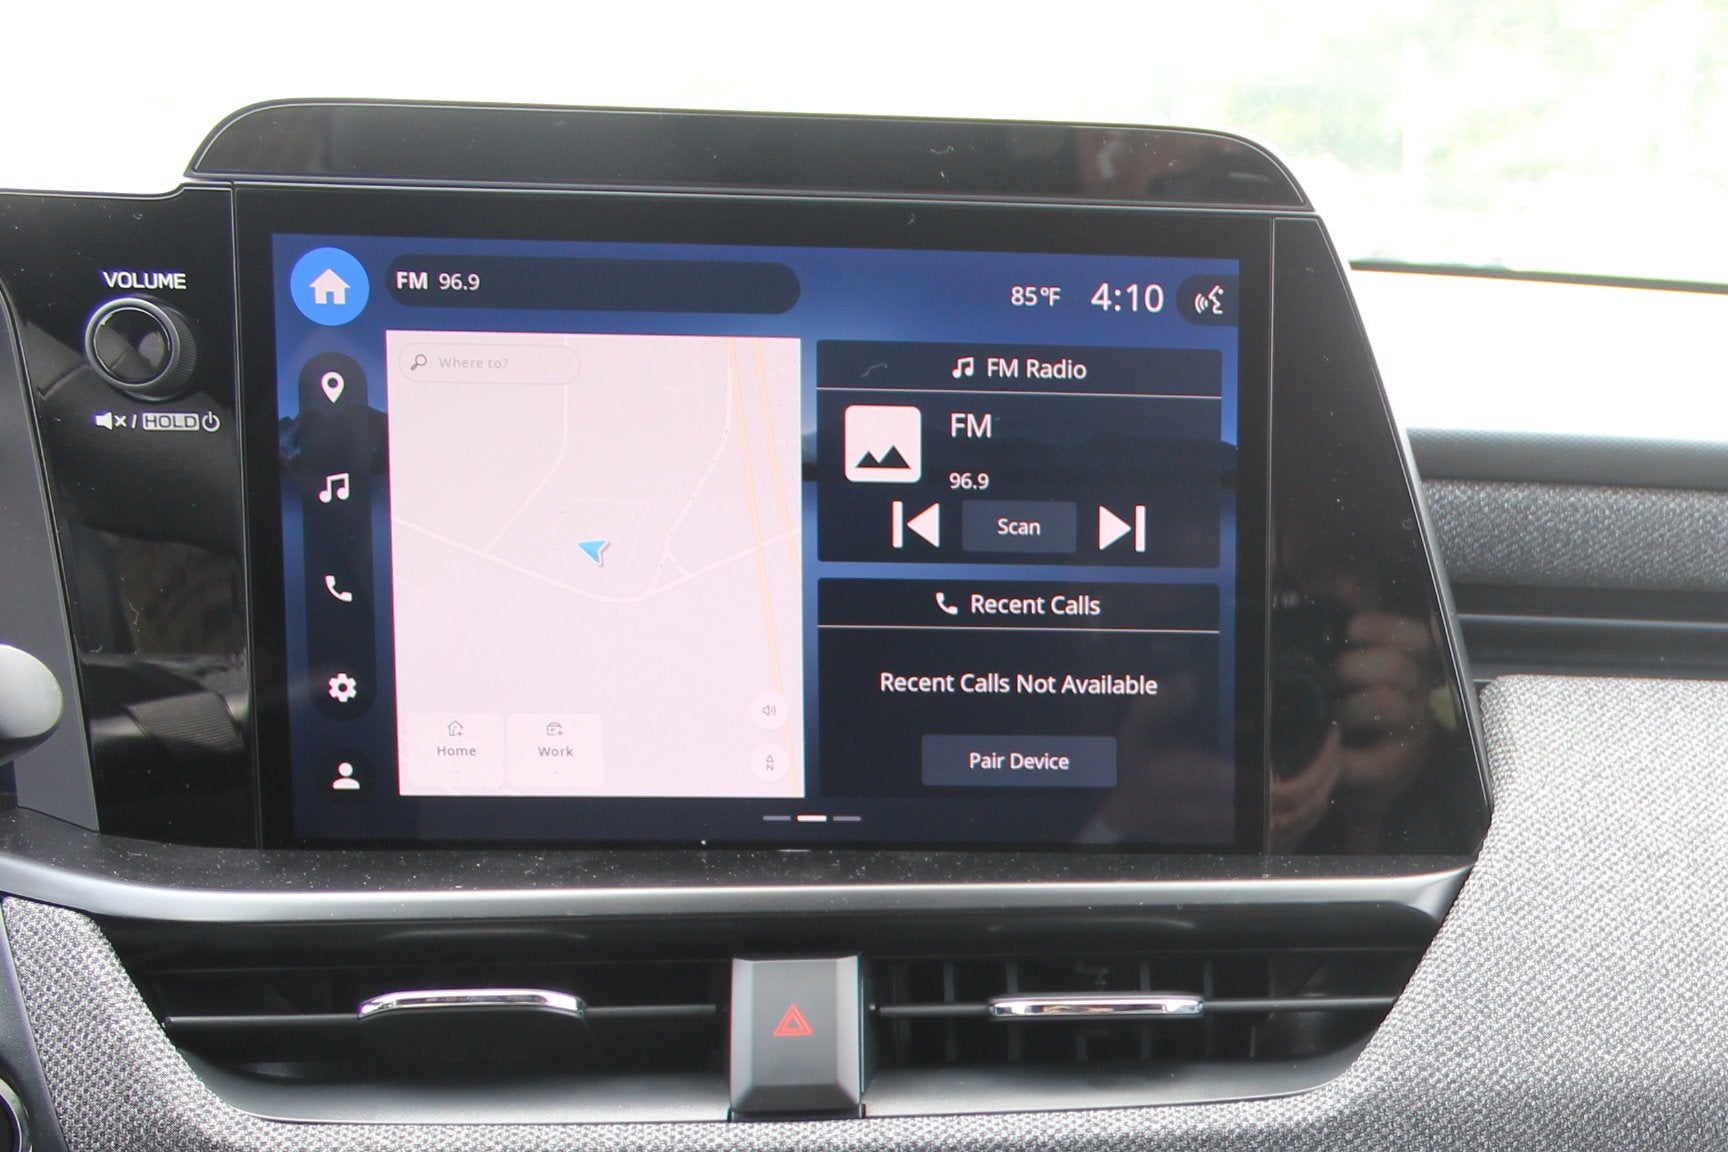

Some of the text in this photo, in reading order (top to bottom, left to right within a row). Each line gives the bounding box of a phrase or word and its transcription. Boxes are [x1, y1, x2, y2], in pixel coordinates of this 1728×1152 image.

[103, 271, 187, 290] VOLUME
[397, 272, 481, 291] FM 96.9
[1091, 283, 1164, 313] 4:10
[438, 356, 510, 370] Where to?
[987, 358, 1087, 380] FM Radio
[144, 414, 198, 429] HOLD
[950, 413, 993, 439] FM
[949, 472, 989, 491] 96.9
[997, 517, 1041, 536] Scan
[970, 594, 1101, 616] Recent Calls
[880, 672, 1158, 696] Recent Calls Not Available
[436, 744, 477, 757] Home
[538, 744, 574, 757] Work
[969, 752, 1069, 771] Pair Device
